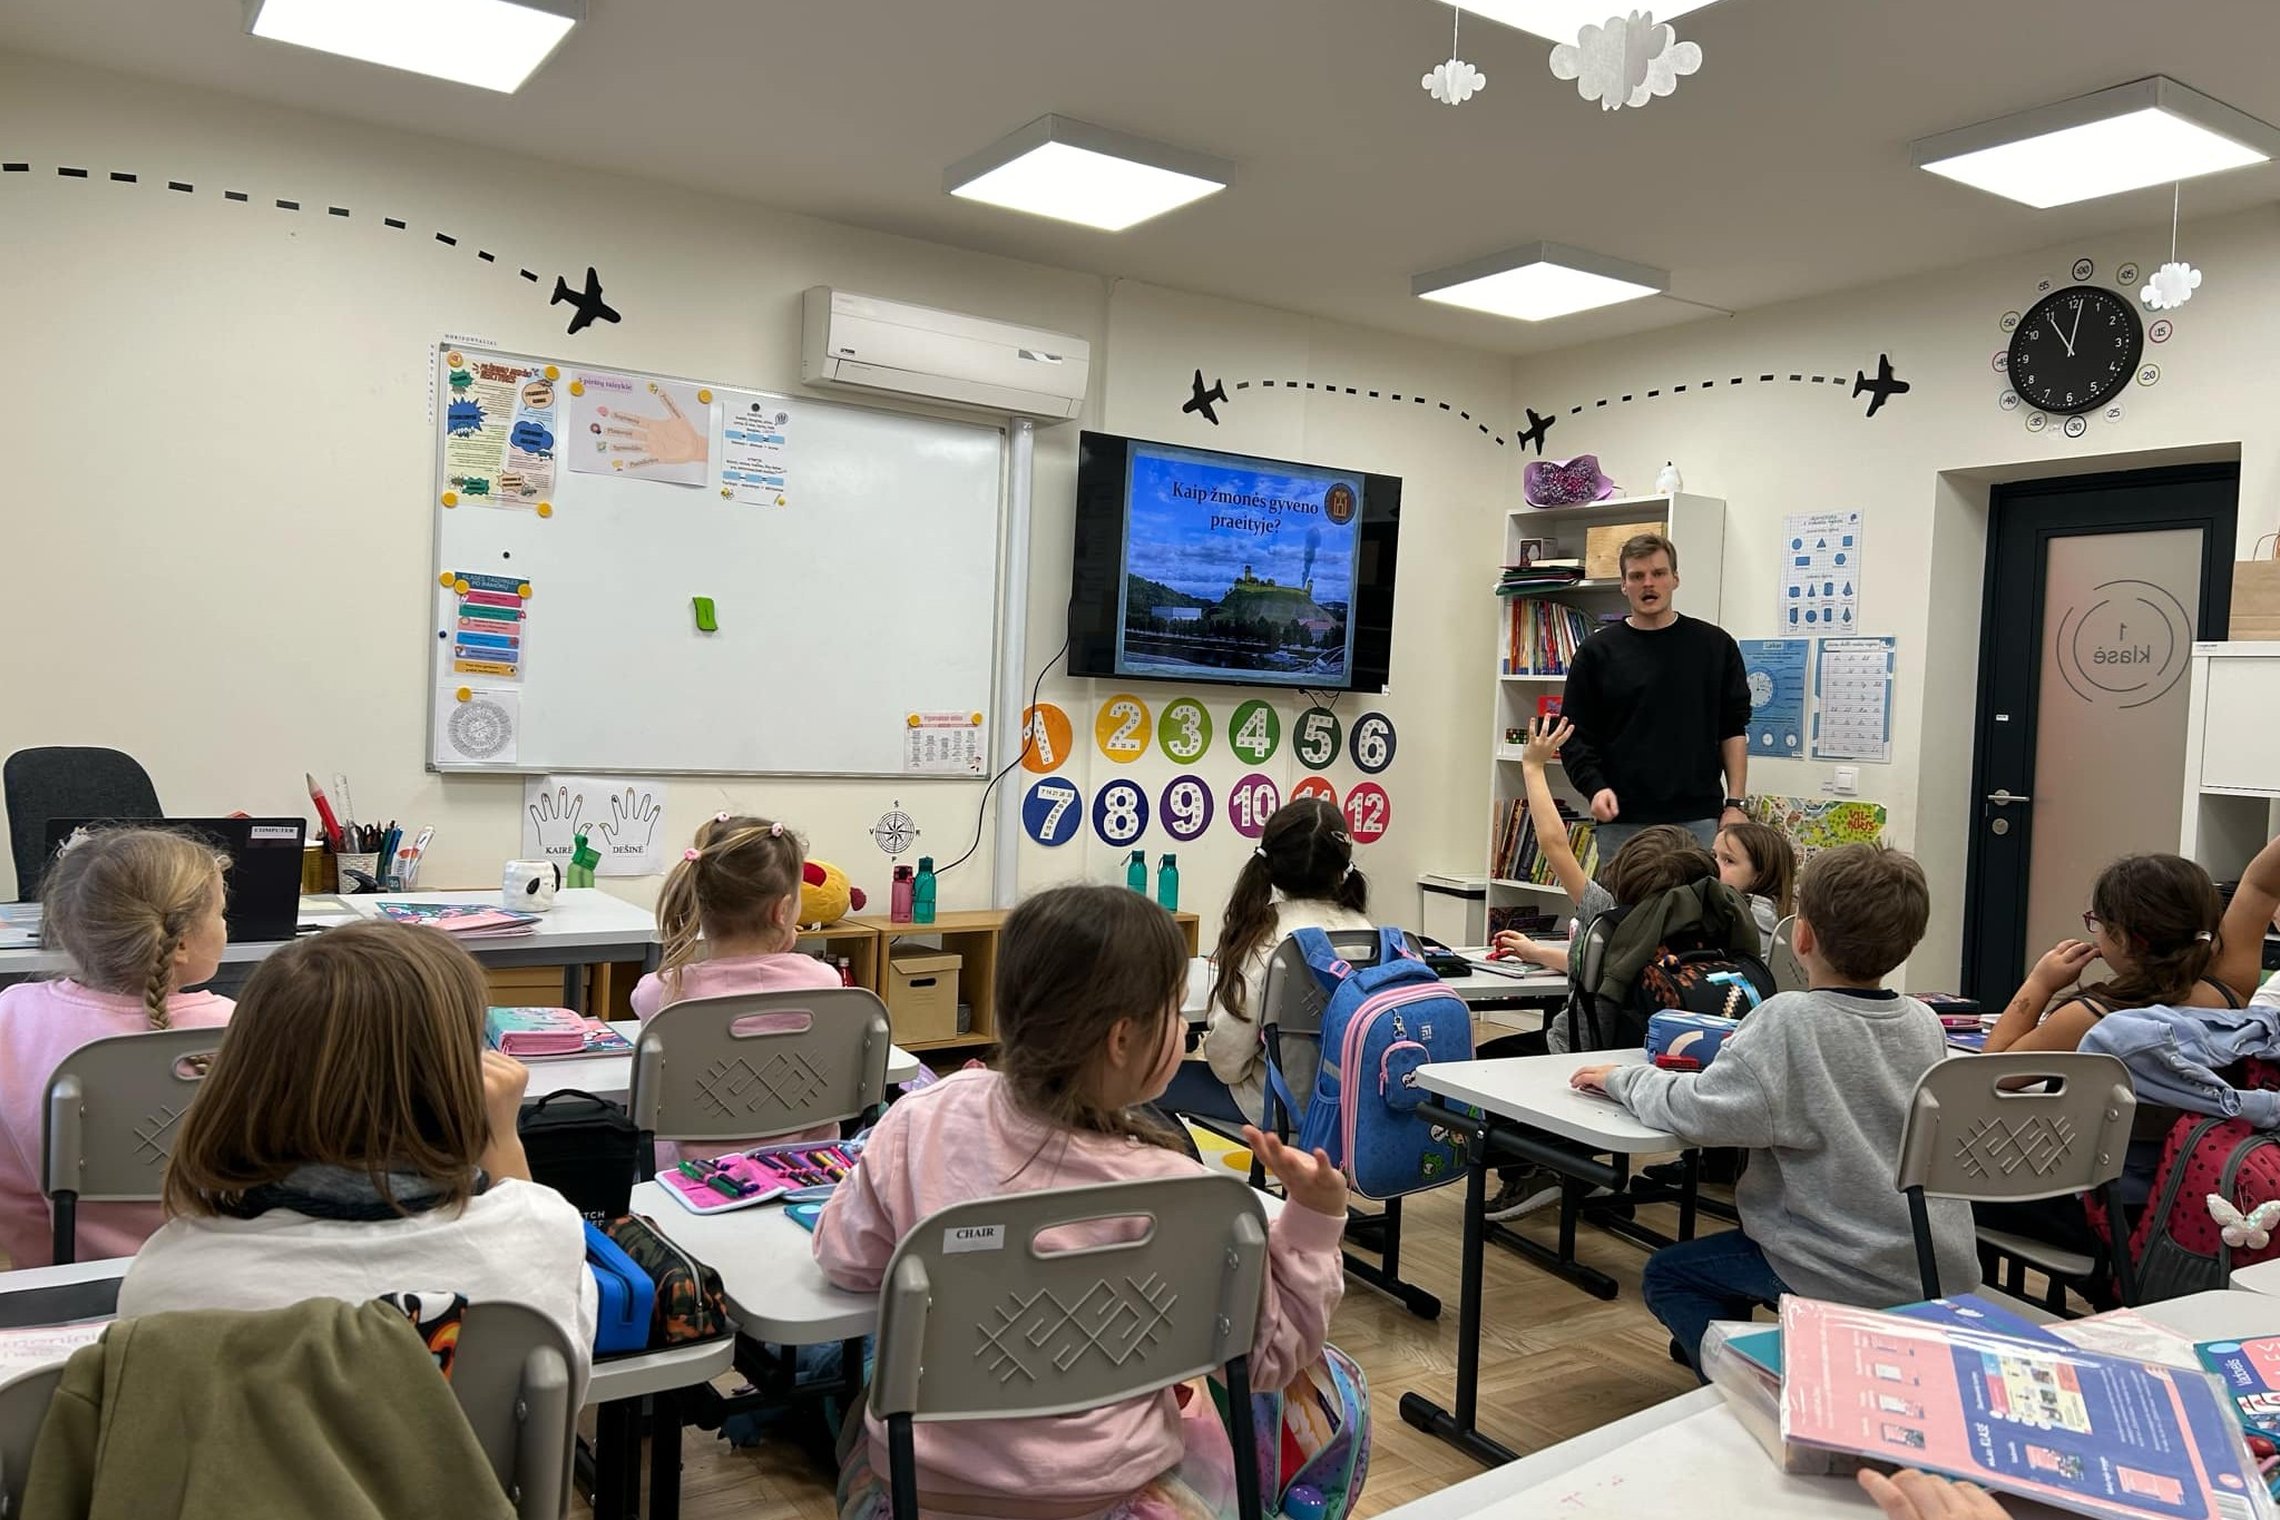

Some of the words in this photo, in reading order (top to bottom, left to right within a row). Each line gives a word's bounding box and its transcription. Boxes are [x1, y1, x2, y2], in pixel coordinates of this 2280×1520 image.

[2069, 300, 2079, 310] 12
[2096, 303, 2101, 312] 1
[2109, 316, 2117, 326] 2
[2029, 331, 2040, 341] 10
[2115, 338, 2123, 348] 3
[2022, 354, 2030, 364] 9
[2109, 362, 2117, 371] 4
[2028, 375, 2035, 385] 8
[2090, 382, 2098, 392] 5
[2044, 389, 2051, 399] 7
[2066, 392, 2074, 403] 6
[1172, 481, 1208, 501] Kaip
[1210, 489, 1266, 508] žmonės
[1269, 499, 1319, 515] gyveno
[1210, 512, 1281, 535] praeityje?
[1106, 701, 1141, 751] 2
[1168, 704, 1203, 756] 3
[1236, 708, 1270, 757] 4
[1023, 710, 1055, 766] 1
[1300, 714, 1334, 763] 5
[1358, 719, 1389, 767] 6
[1037, 785, 1075, 840] 7
[1103, 786, 1139, 839] 8
[1170, 782, 1204, 834] 9
[1233, 784, 1277, 827] 10
[1348, 792, 1384, 832] 12
[956, 1228, 994, 1239] CHAIR
